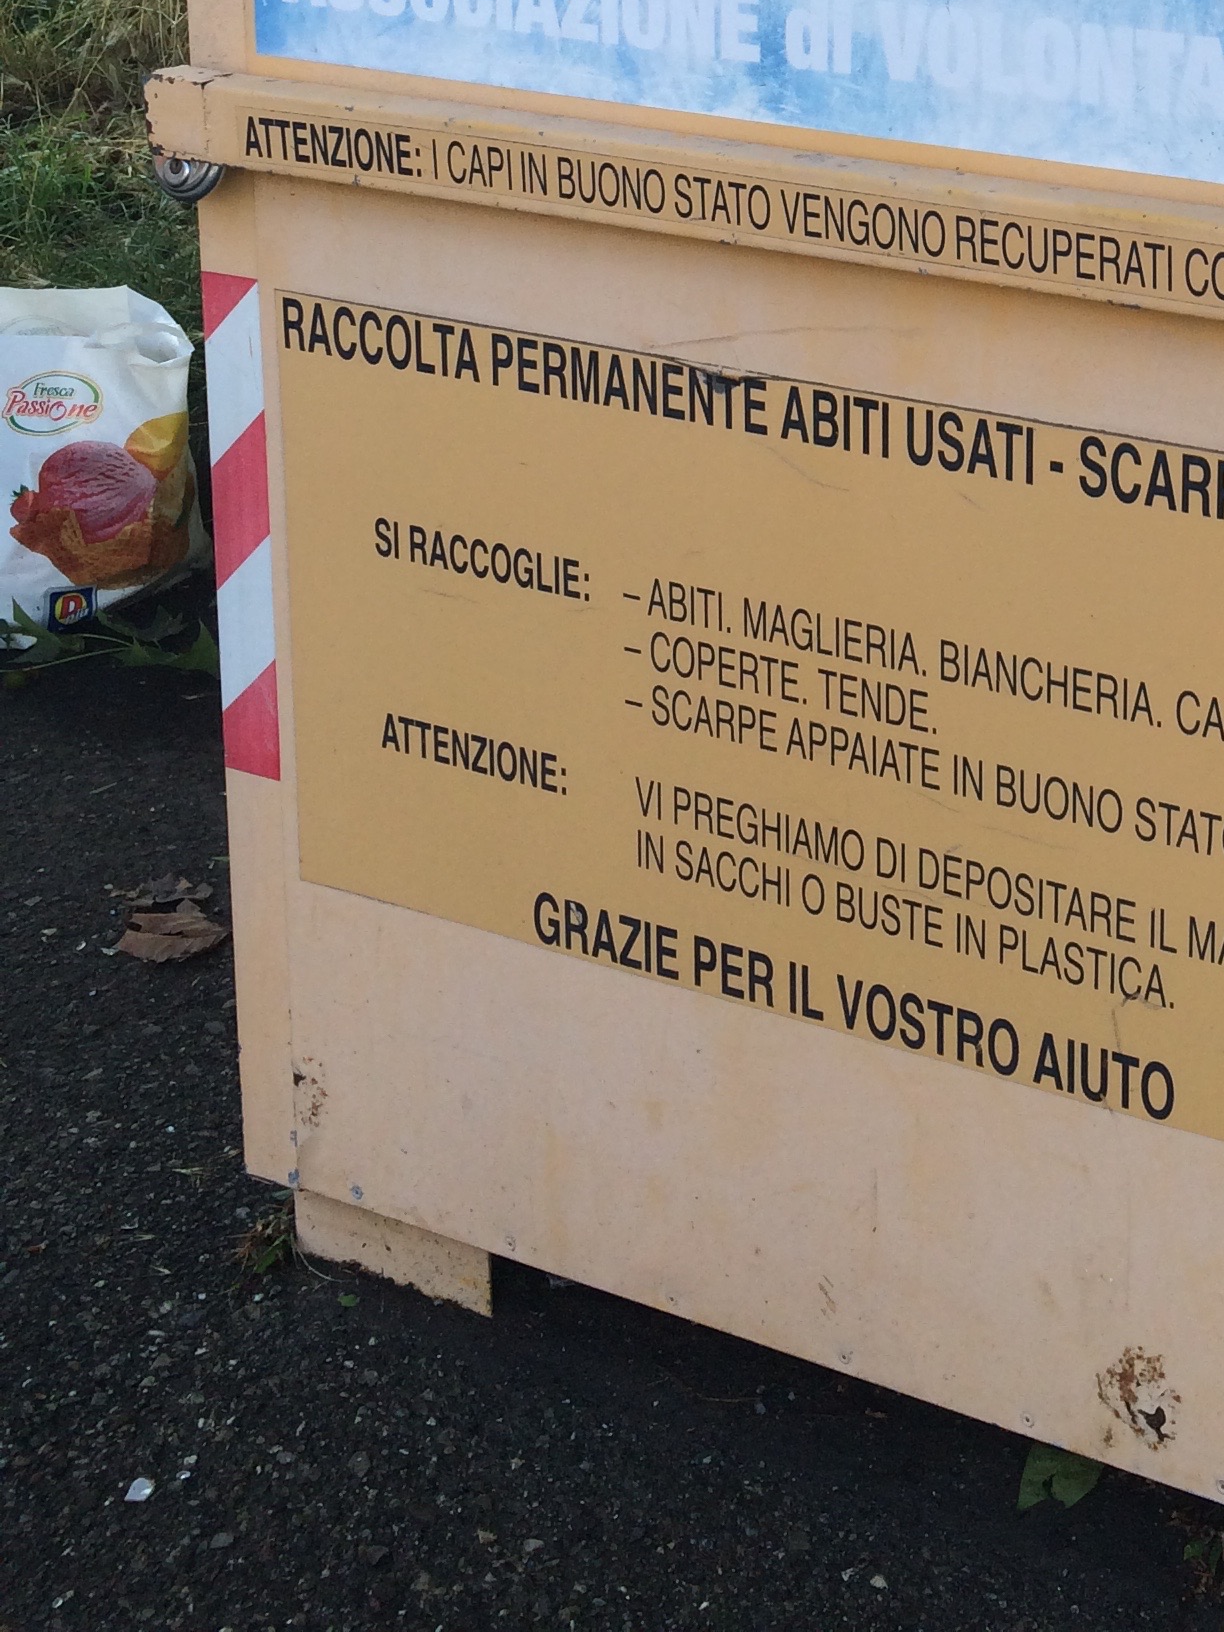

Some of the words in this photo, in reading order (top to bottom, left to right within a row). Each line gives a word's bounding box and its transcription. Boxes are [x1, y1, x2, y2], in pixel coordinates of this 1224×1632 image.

[245, 115, 423, 178] ATTENZIONE:
[431, 138, 438, 180] I
[447, 140, 513, 191] CAPI
[520, 150, 548, 196] IN
[557, 156, 666, 214] BUONO
[674, 173, 771, 231] STATO
[780, 189, 946, 257] VENGONO
[956, 215, 1173, 292] RECUPERATI
[282, 297, 480, 383] RACCOLTA
[492, 332, 768, 436] PERMANENTE
[780, 385, 889, 459] ABITI
[905, 406, 1035, 486] USATI
[374, 517, 400, 559] SI
[409, 524, 591, 602] RACCOGLIE:
[647, 578, 732, 634] ABITI.
[743, 597, 927, 677] MAGLIERIA.
[939, 638, 1162, 729] BIANCHERIA.
[650, 631, 807, 705] COPERTE.
[818, 668, 937, 735] TENDE.
[381, 712, 567, 796] ATTENZIONE:
[651, 684, 777, 752] SCARPE
[786, 717, 940, 790] APPAIATE
[953, 753, 983, 801] IN
[996, 763, 1123, 834] BUONO
[635, 776, 662, 821] VI
[673, 785, 865, 872] PREGHIAMO
[876, 837, 905, 883] DI
[919, 848, 1136, 944] DEPOSITARE
[1149, 906, 1177, 954] IL
[637, 829, 665, 874] IN
[675, 840, 790, 908] SACCHI
[801, 873, 825, 916] O
[836, 880, 944, 949] BUSTE
[956, 913, 986, 960] IN
[999, 923, 1175, 1010] PLASTICA.
[533, 892, 679, 981] GRAZIE
[694, 934, 774, 1008] PER
[789, 965, 824, 1021] IL
[837, 973, 1021, 1077] VOSTRO
[1033, 1031, 1176, 1121] AIUTO
